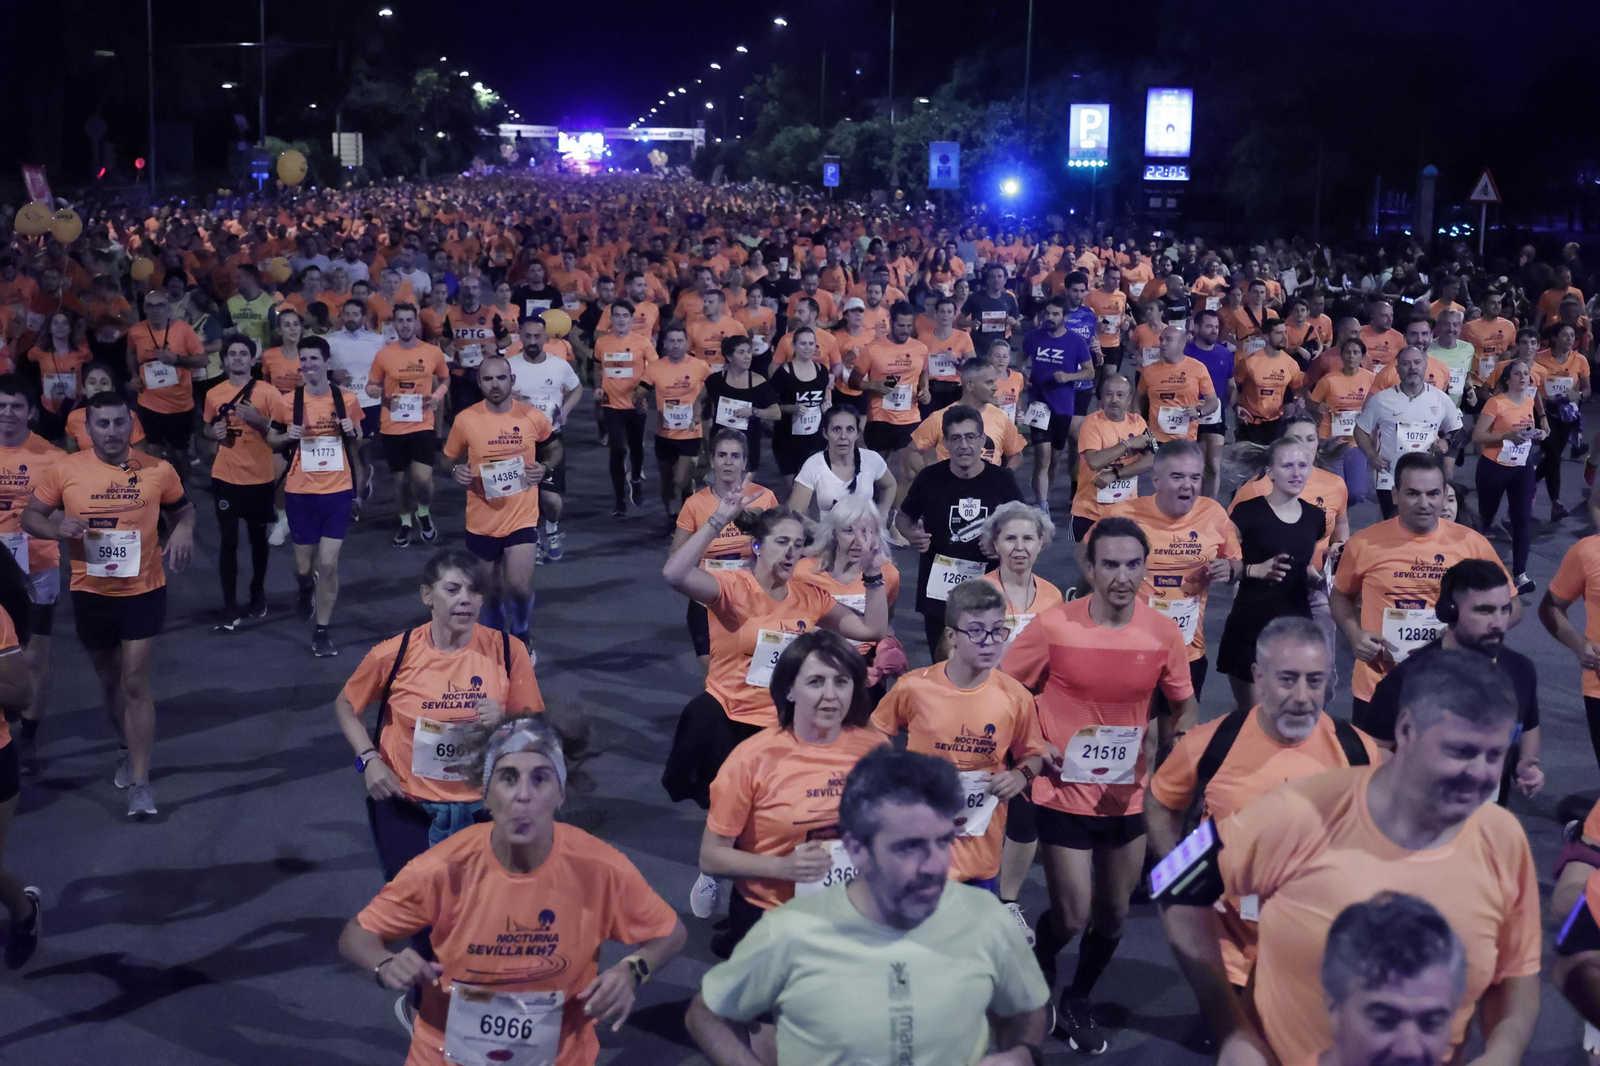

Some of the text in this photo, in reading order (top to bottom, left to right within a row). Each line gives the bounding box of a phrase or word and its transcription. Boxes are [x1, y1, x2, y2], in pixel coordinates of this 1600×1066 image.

[1146, 165, 1187, 178] 22:05
[455, 329, 485, 339] ZPTG
[1037, 347, 1064, 359] KZ
[796, 390, 823, 401] KZ
[800, 415, 817, 424] 18127
[1167, 415, 1183, 424] 3475
[1405, 431, 1429, 440] 10797
[311, 448, 336, 457] 11773
[492, 470, 519, 483] 14385
[99, 546, 127, 558] 5948
[1398, 628, 1437, 640] 12828
[954, 736, 997, 747] NOCTURNA
[935, 742, 972, 753] SEVILLA
[1082, 744, 1126, 760] 21518
[497, 934, 559, 943] NOCTURNA
[467, 943, 523, 956] SEVILLA
[480, 1014, 533, 1039] 6966
